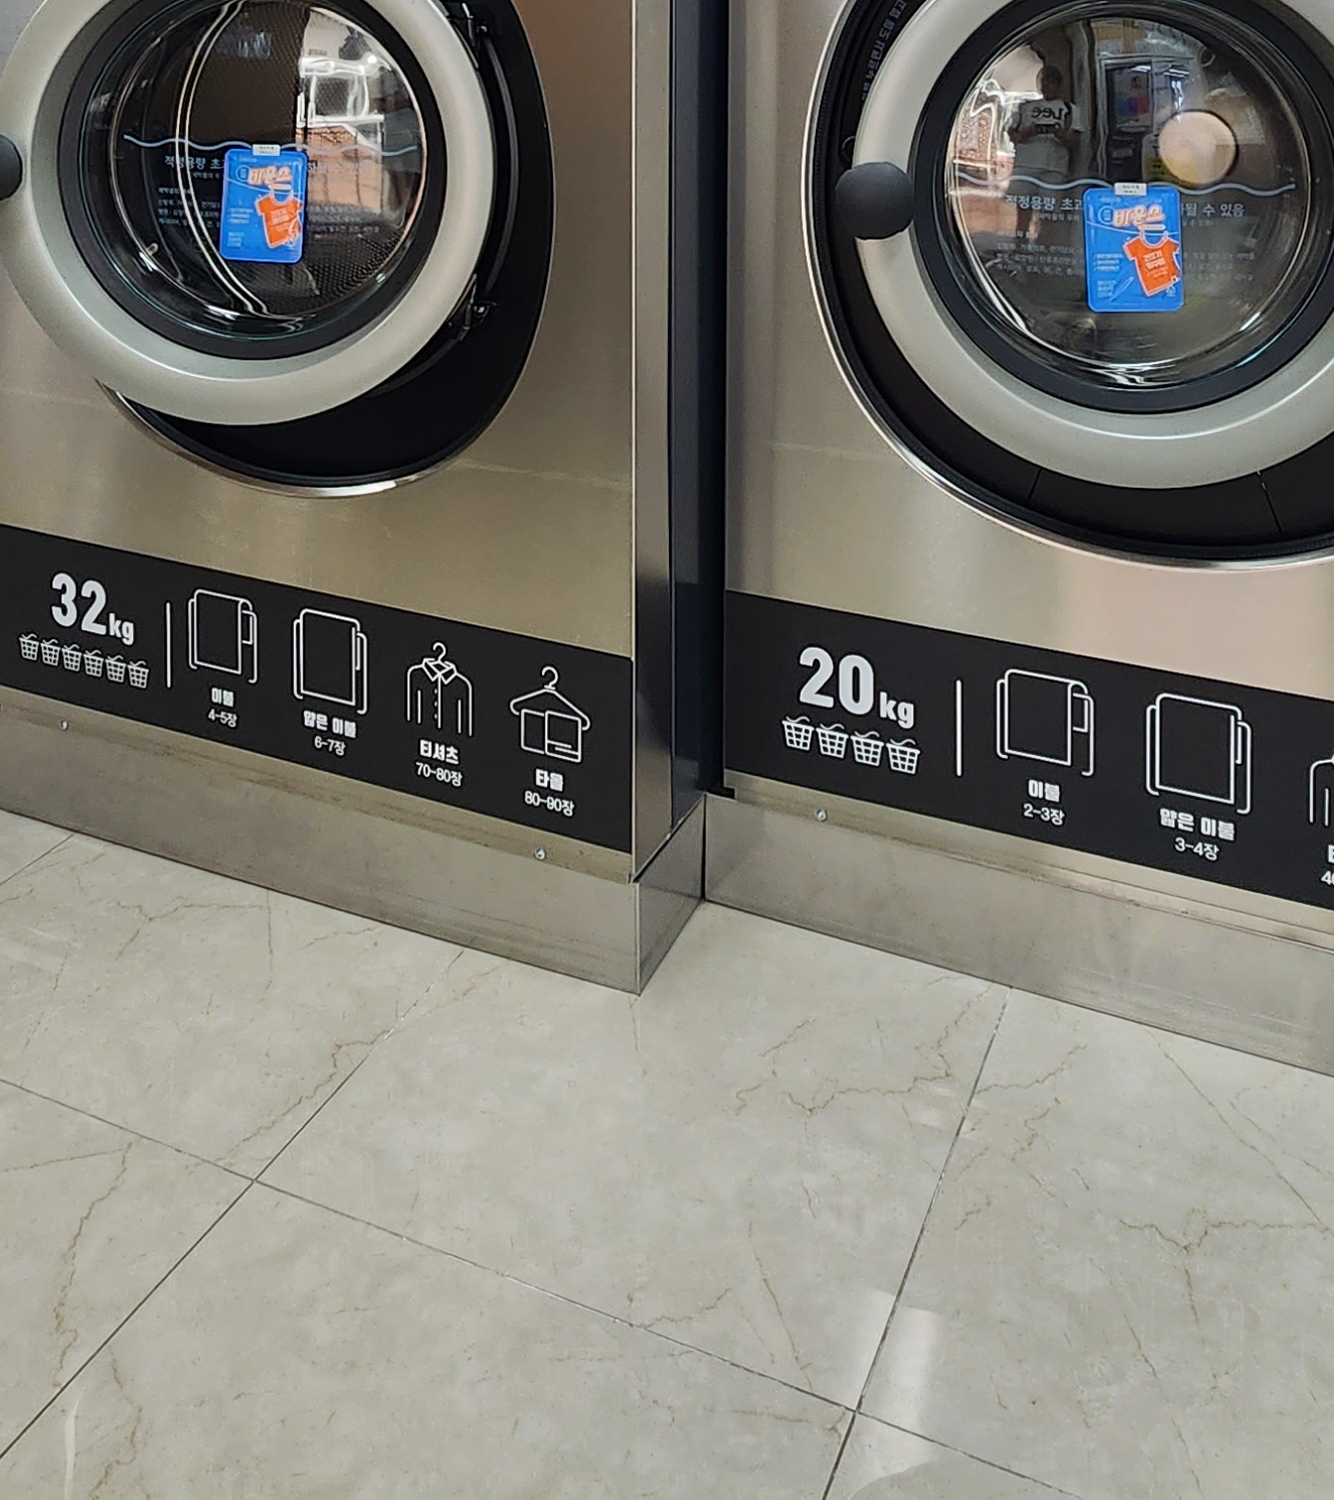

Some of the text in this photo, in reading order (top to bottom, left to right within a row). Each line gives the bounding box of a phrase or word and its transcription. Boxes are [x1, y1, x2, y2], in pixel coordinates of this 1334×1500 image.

[51, 572, 134, 646] 32kg
[211, 687, 235, 707] 이불
[799, 646, 915, 729] 20kg
[208, 708, 237, 728] 4-5장
[304, 710, 357, 739] 얇은 이불
[315, 735, 346, 756] 6-7장
[419, 739, 459, 765] 티셔츠
[416, 761, 463, 787] 70-80장
[536, 769, 564, 792] 타올
[524, 790, 574, 816] 80-90장
[1028, 779, 1060, 802] 이불
[1024, 803, 1065, 826] 2-3장
[1160, 808, 1235, 841] 얇은 이불
[1174, 837, 1220, 861] 3-4장
